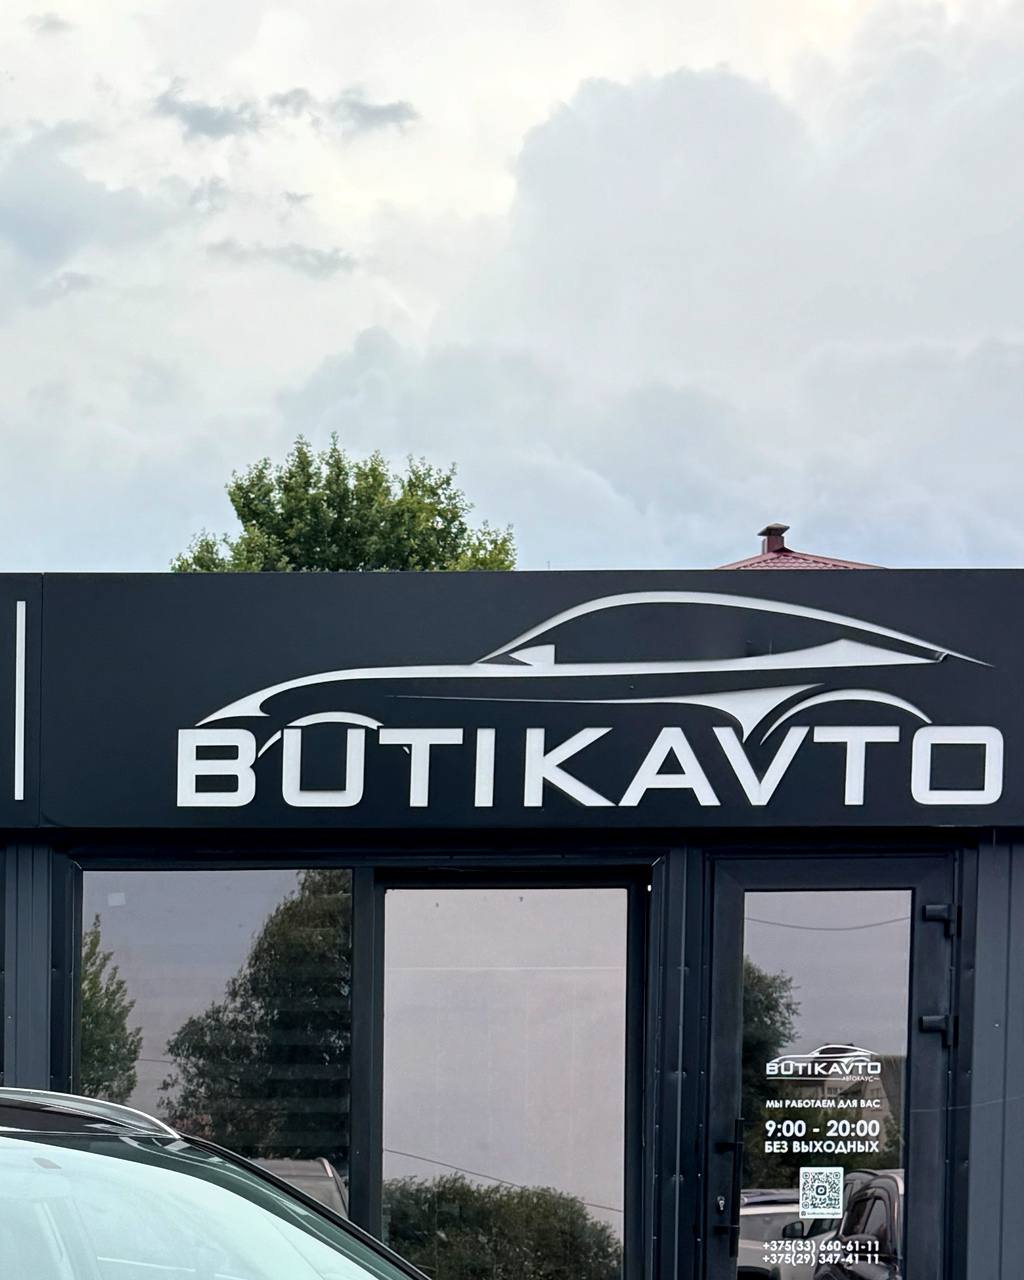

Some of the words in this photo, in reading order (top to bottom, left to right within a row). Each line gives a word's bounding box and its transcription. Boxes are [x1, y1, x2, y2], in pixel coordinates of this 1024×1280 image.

[177, 724, 1004, 807] BUTIKAVTO
[765, 1061, 882, 1075] BUTIKAVTO
[765, 1099, 783, 1109] МЫ
[785, 1099, 836, 1109] РАБОТАЕМ
[837, 1099, 857, 1109] ДЛЯ
[860, 1099, 881, 1109] ВАС
[764, 1119, 807, 1137] 9:00
[825, 1119, 881, 1137] 20:00
[764, 1140, 789, 1153] БЕЗ
[792, 1140, 880, 1154] ВЫХОДНЫХ
[762, 1240, 816, 1253] +375(33)
[818, 1240, 880, 1252] 660-61-11
[762, 1253, 816, 1267] +375(29)
